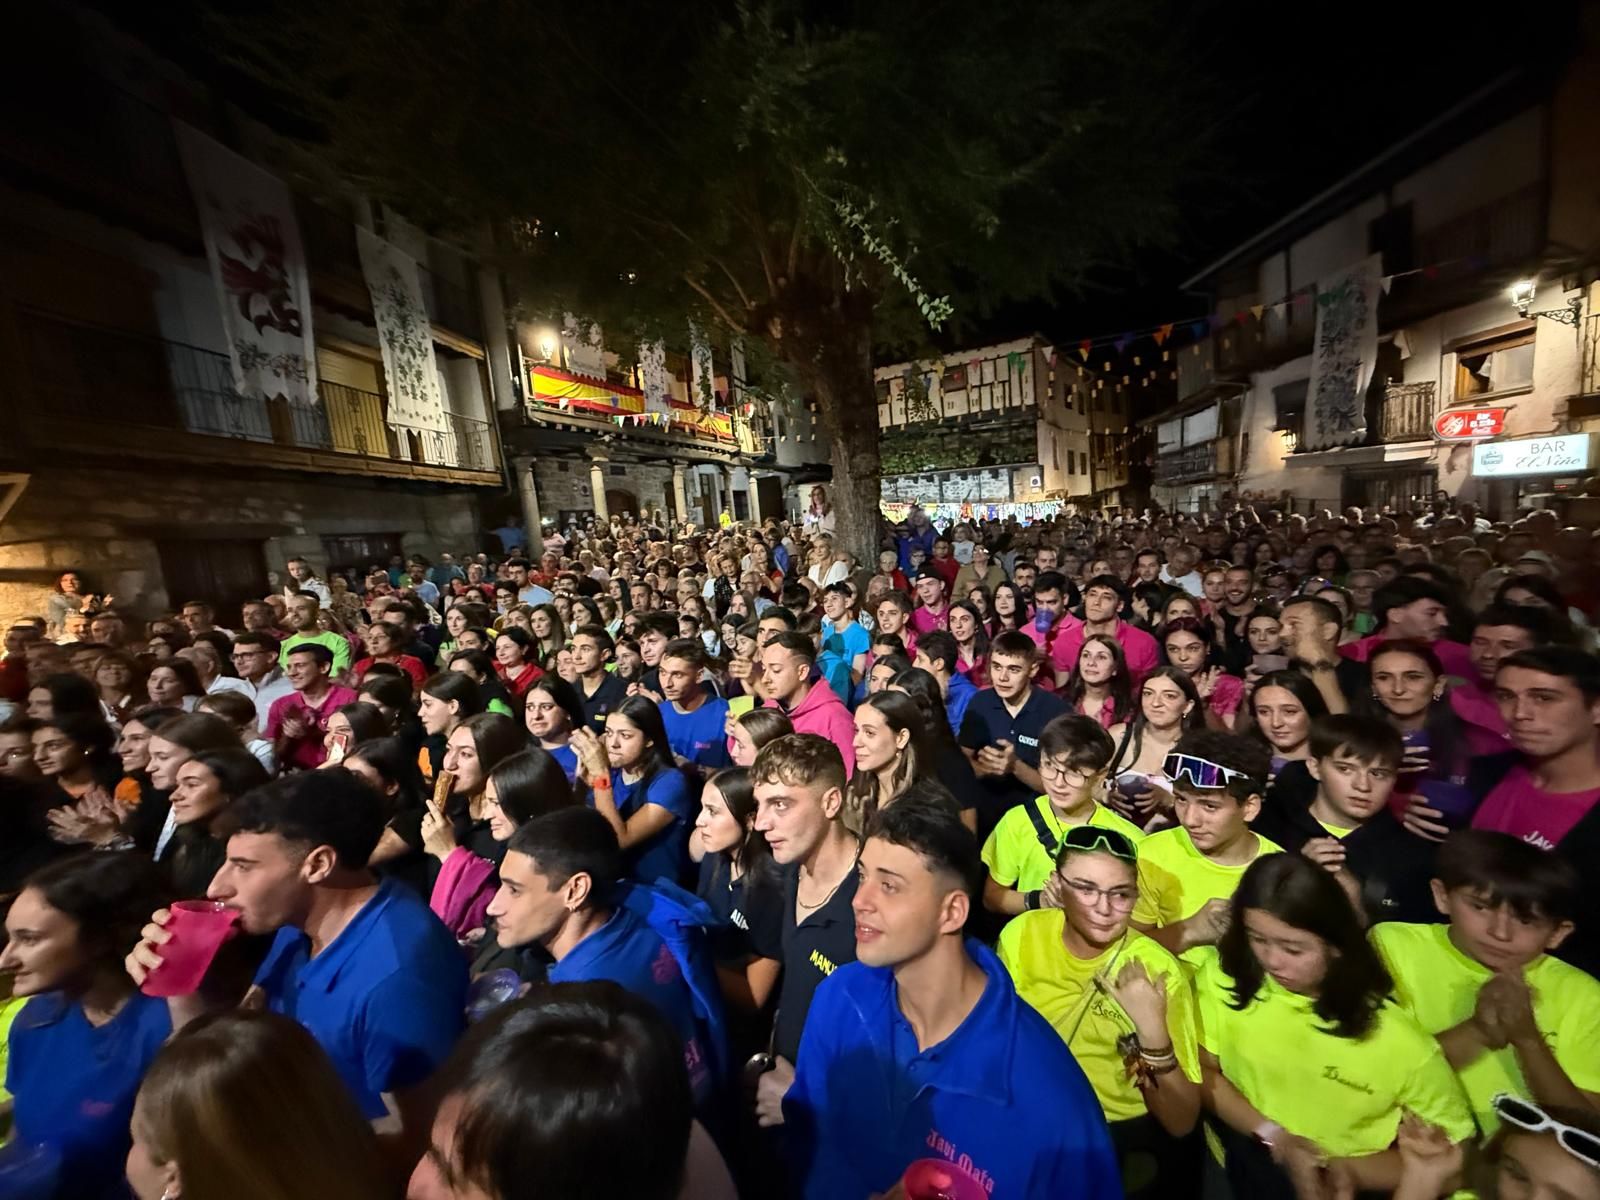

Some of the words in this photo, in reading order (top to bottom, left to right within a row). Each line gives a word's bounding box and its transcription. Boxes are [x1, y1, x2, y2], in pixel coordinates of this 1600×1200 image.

[1531, 441, 1565, 454] BAR
[1515, 456, 1537, 468] El
[1537, 454, 1581, 468] Niño
[927, 1128, 956, 1161] Javi
[959, 1153, 995, 1193] Mata
